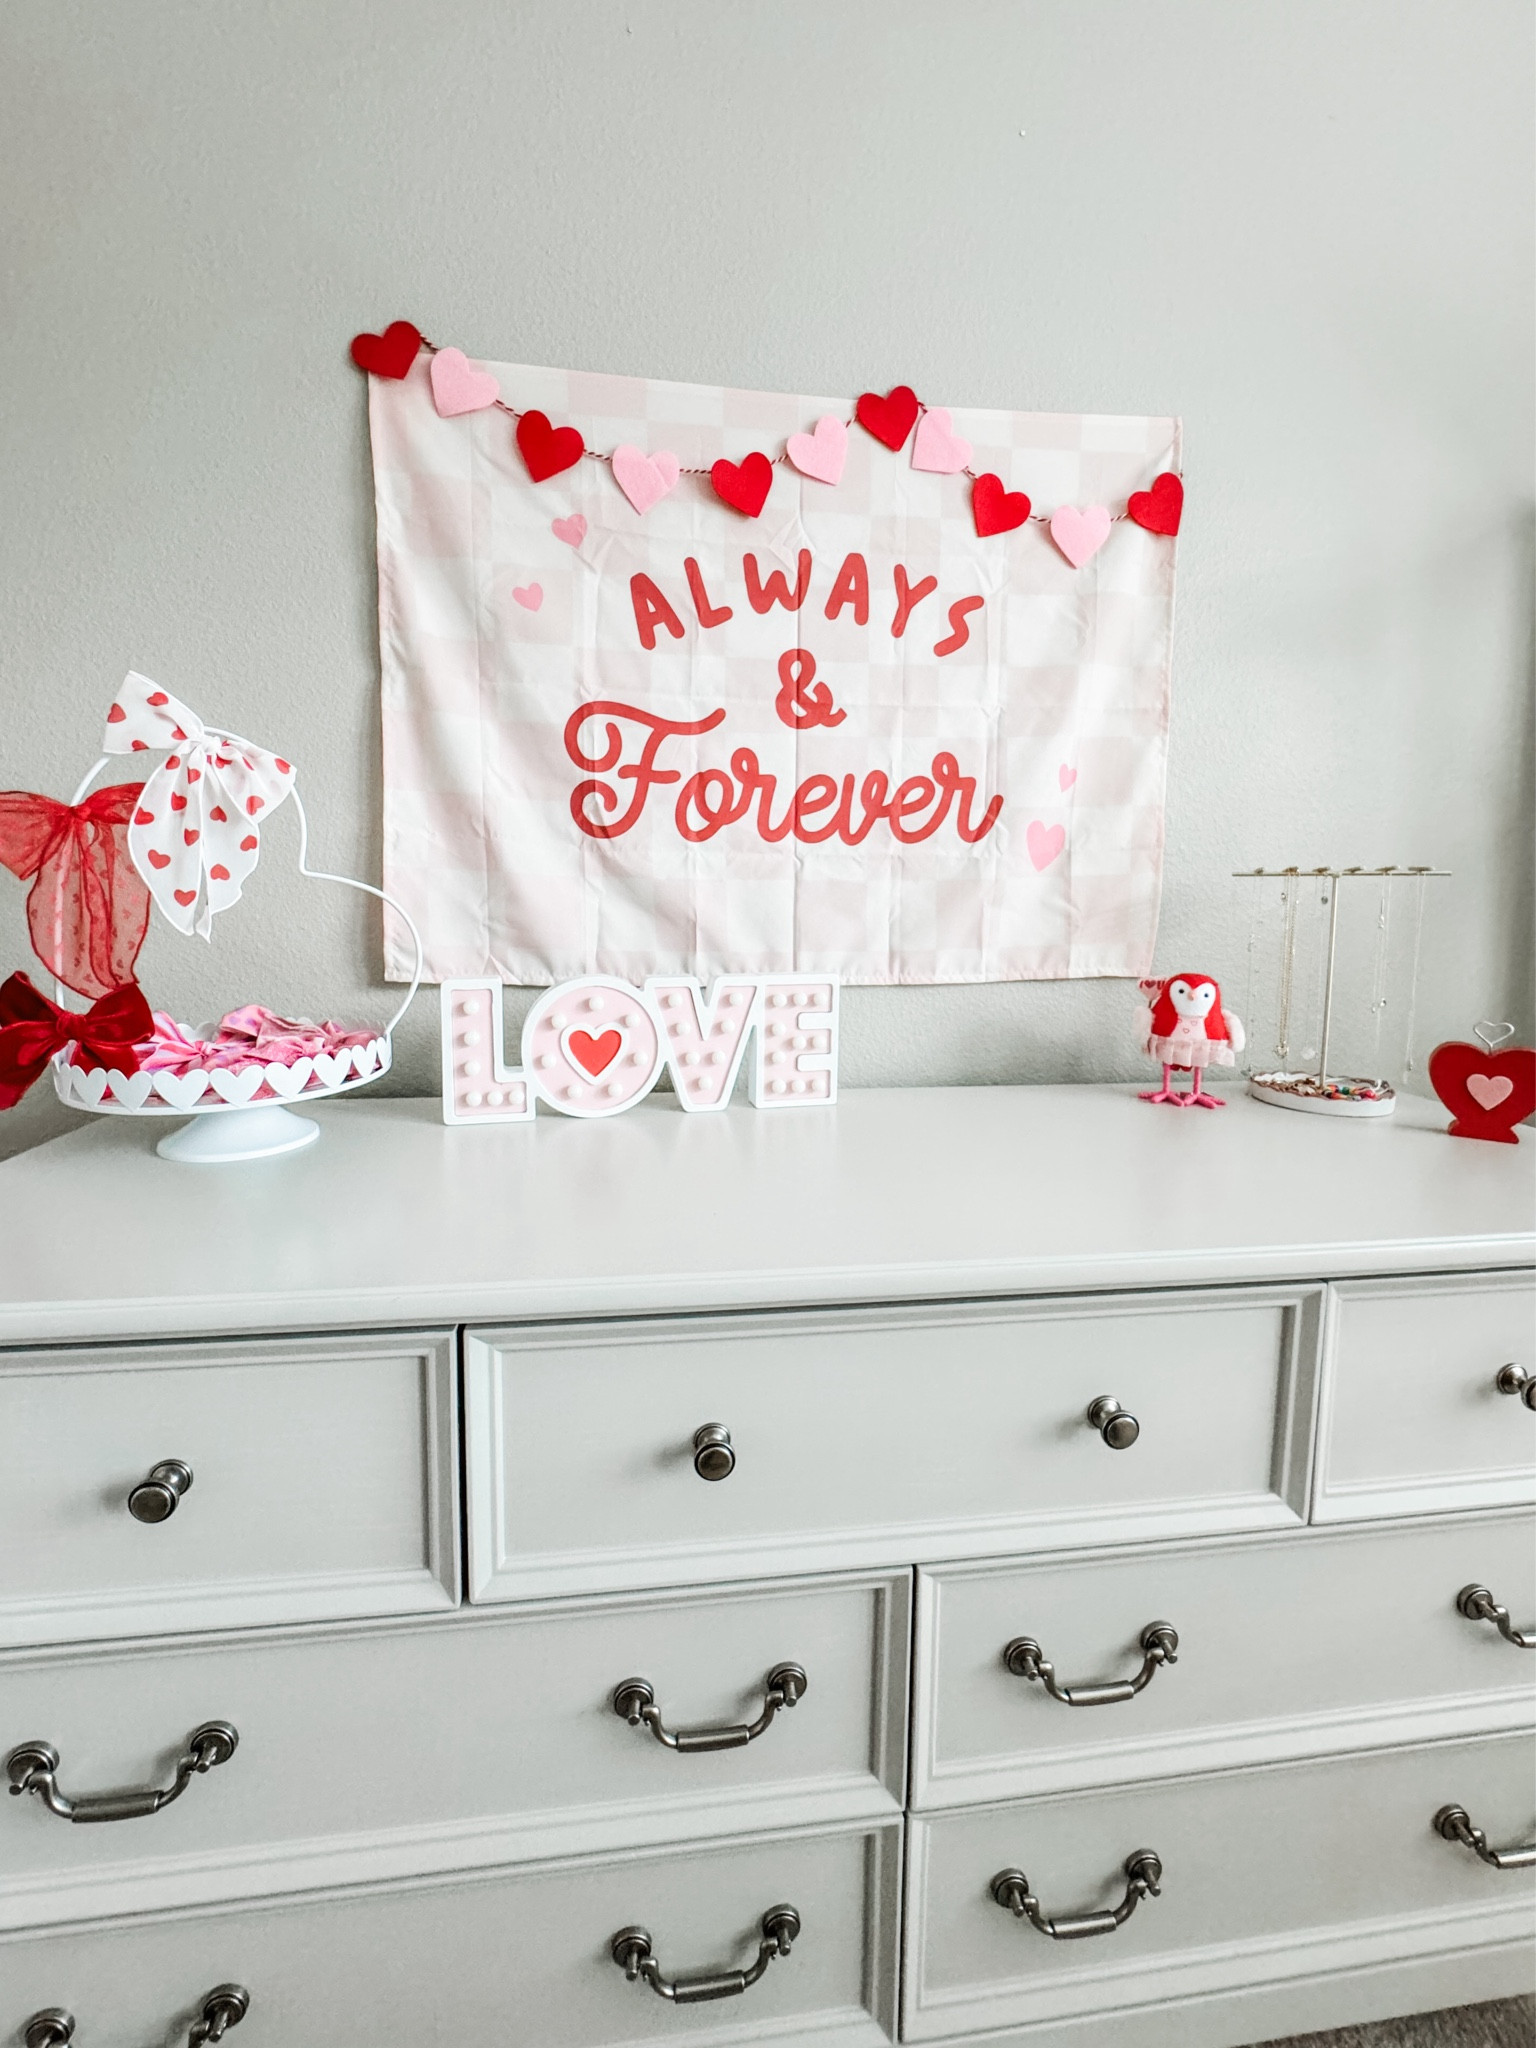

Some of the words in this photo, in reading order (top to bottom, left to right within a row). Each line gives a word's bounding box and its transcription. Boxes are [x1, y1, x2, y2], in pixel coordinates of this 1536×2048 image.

[630, 548, 985, 656] ALWAYS
[775, 648, 847, 730] &
[564, 700, 1004, 846] Forever
[441, 973, 840, 1126] LOVE
